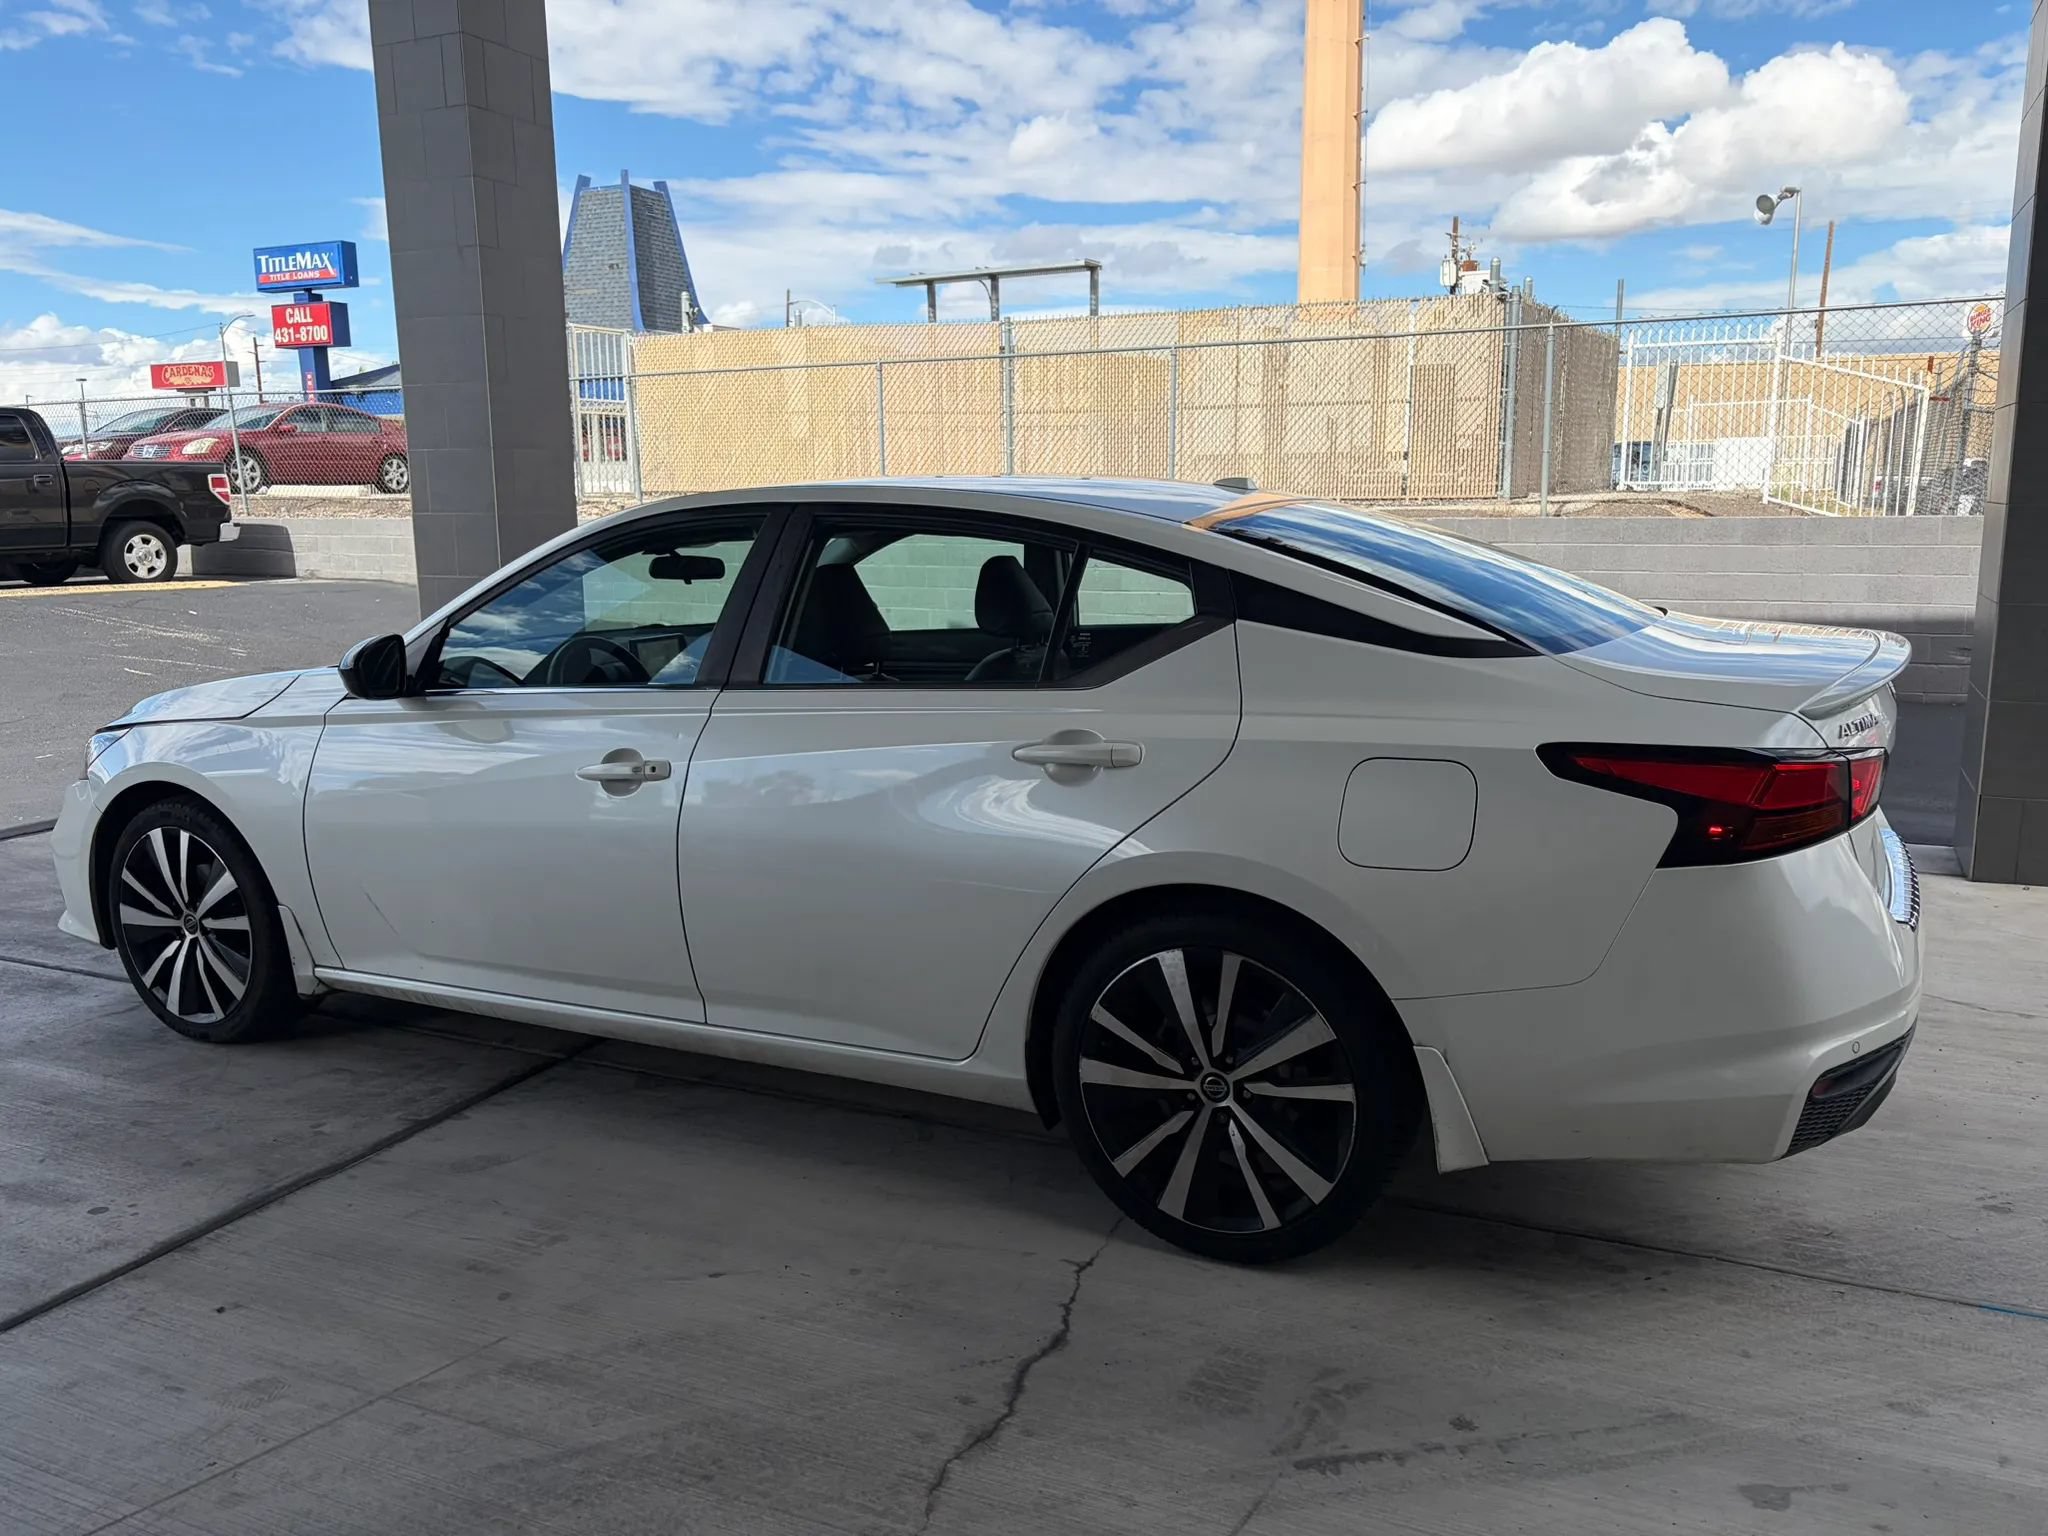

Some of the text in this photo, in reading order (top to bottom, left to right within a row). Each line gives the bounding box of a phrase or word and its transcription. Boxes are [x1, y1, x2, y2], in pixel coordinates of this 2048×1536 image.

[270, 271, 320, 281] TITLE LOANS
[285, 307, 313, 324] CALL
[1970, 314, 1991, 329] KING
[275, 325, 328, 343] 431-8700
